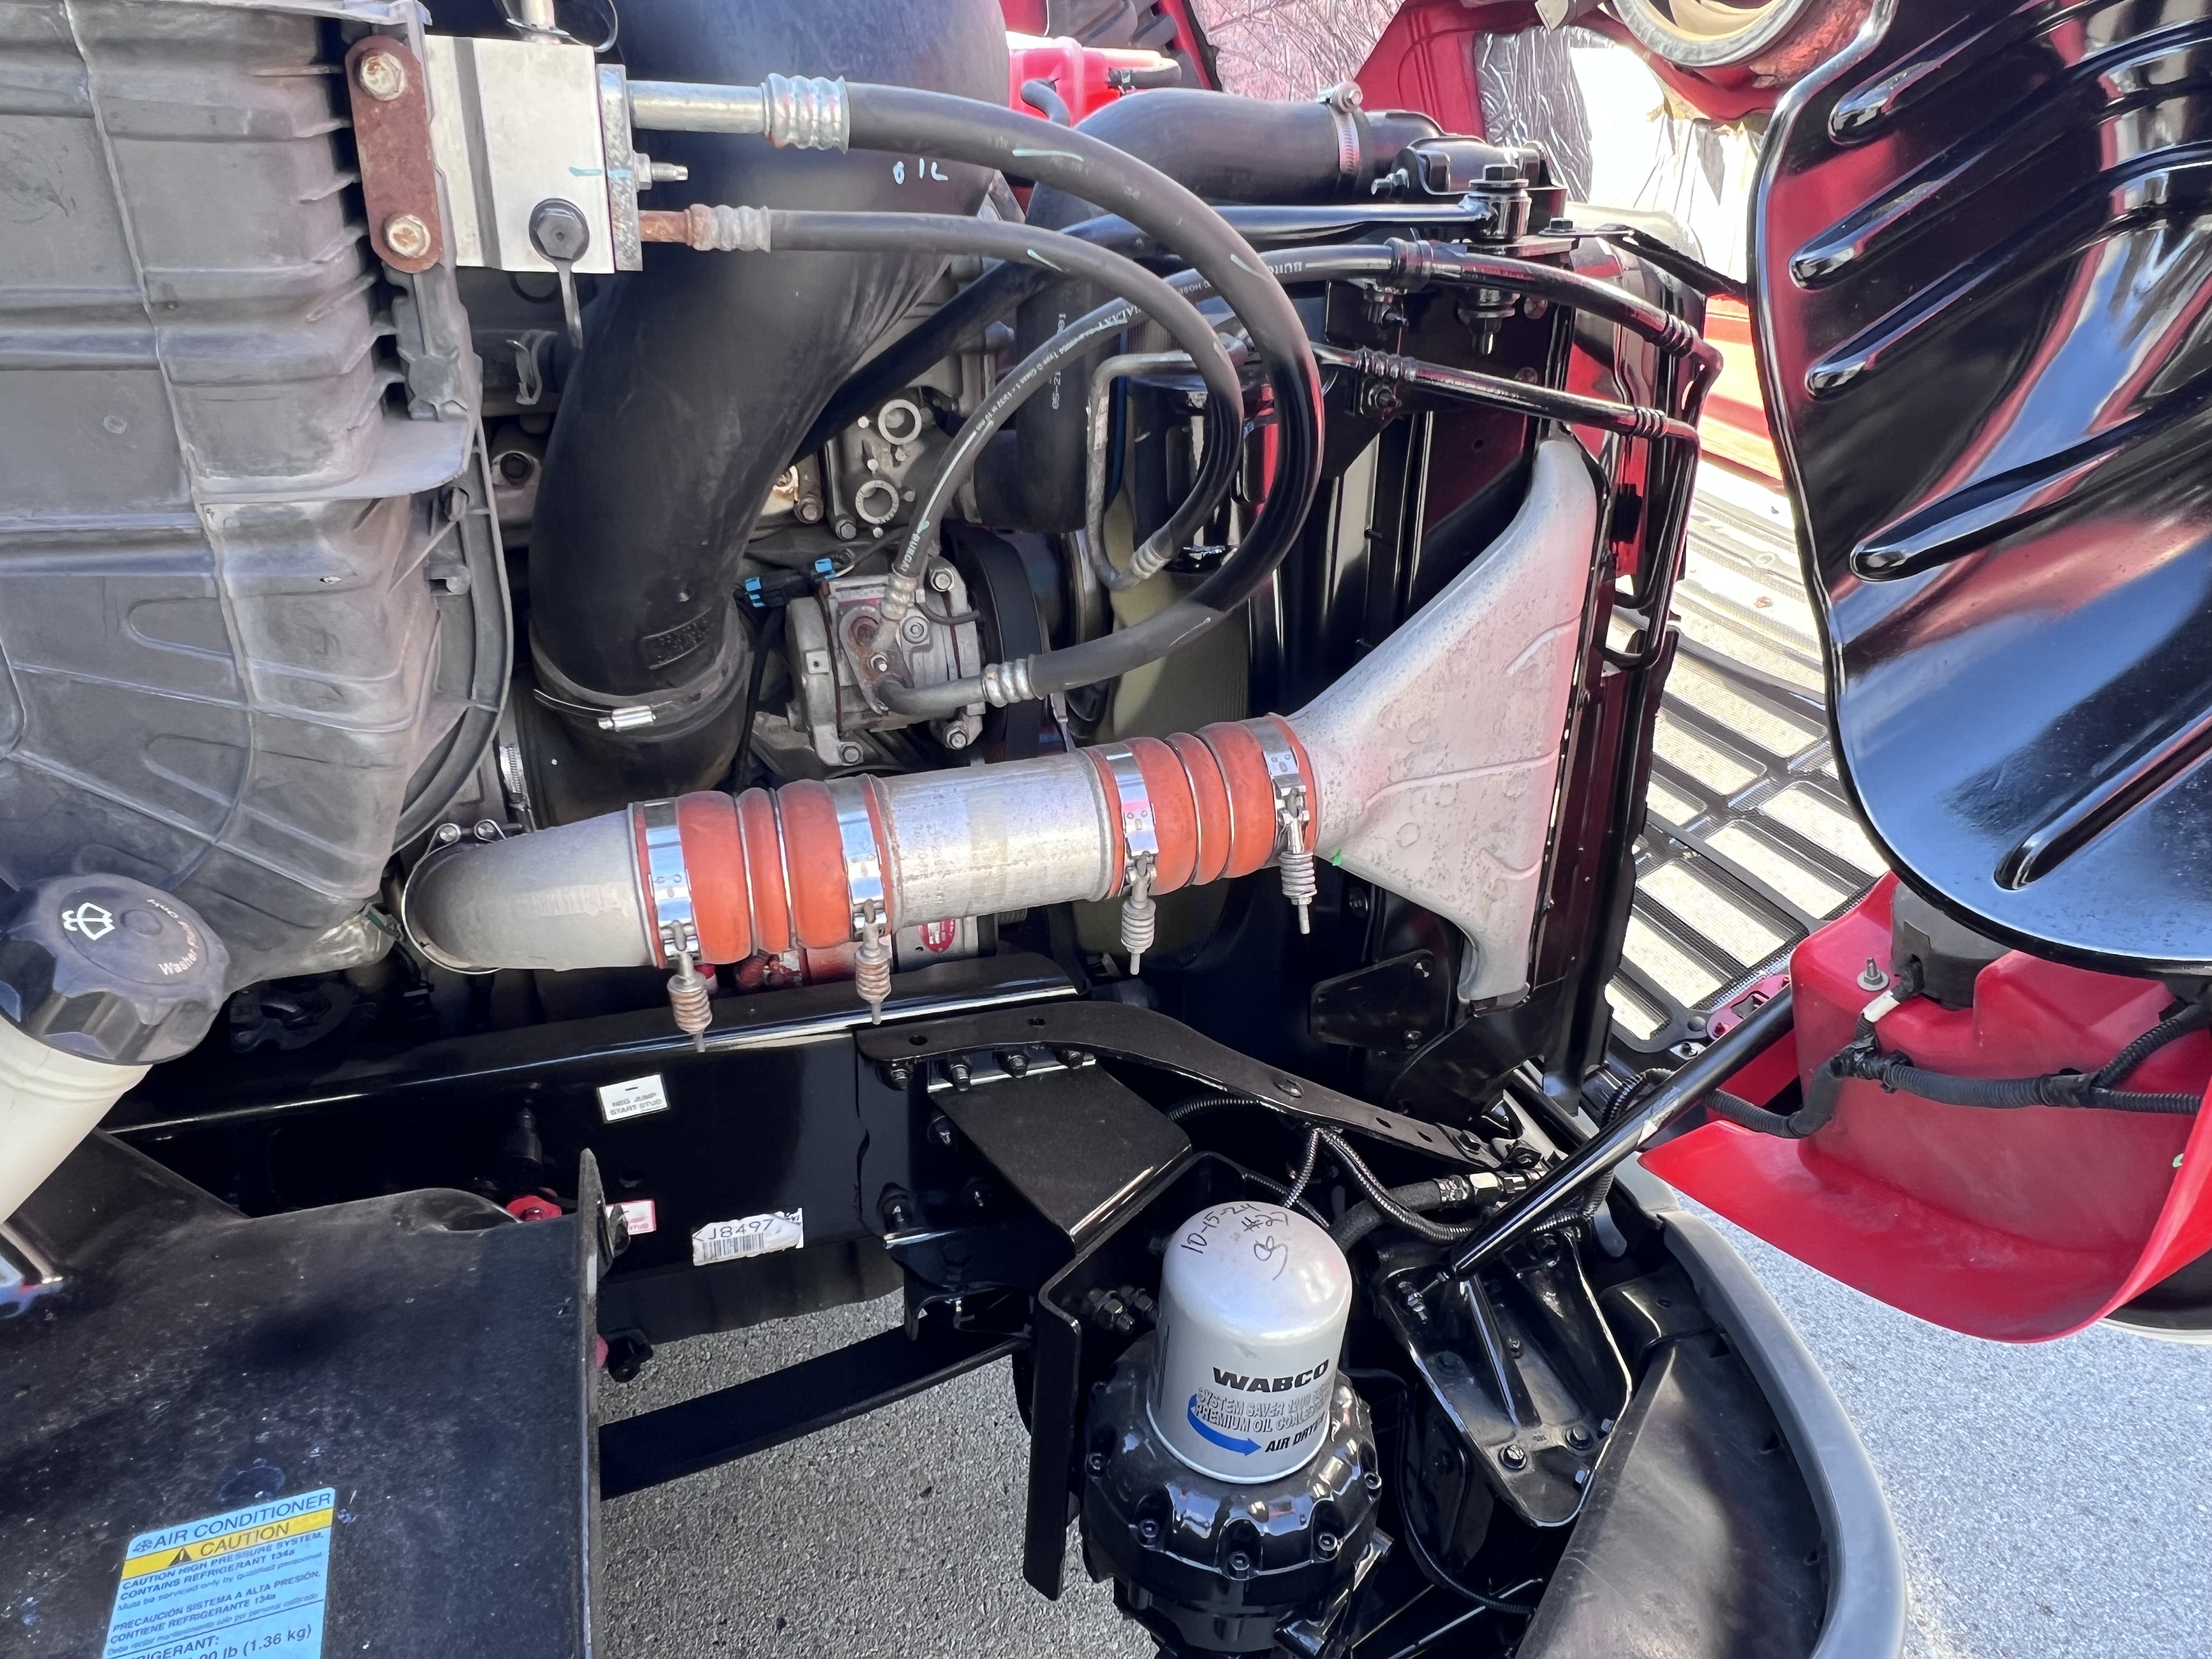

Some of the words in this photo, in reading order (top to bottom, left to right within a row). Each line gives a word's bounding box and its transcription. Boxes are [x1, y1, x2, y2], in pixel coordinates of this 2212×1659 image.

[158, 948, 198, 975] Washer
[1212, 1358, 1329, 1393] WABCO
[1194, 1403, 1251, 1433] PREMIUM
[1252, 1418, 1273, 1433] OIL
[1197, 1386, 1245, 1416] SYSTEM
[1245, 1401, 1285, 1418] SAVER
[1265, 1436, 1291, 1453] AIR
[153, 1529, 188, 1549] AIR
[194, 1493, 331, 1538] CONDITIONER
[200, 1522, 290, 1556] CAUTION
[120, 1578, 181, 1601] CONTAINS
[183, 1555, 267, 1584] REFRIGERANT
[122, 1569, 176, 1590] CAUTION
[210, 1544, 273, 1564] PRESSURE
[234, 1591, 242, 1600] A
[245, 1583, 271, 1596] ALTA
[110, 1622, 166, 1644] CONTIENE
[168, 1599, 250, 1628] REFRIGERANTE
[223, 1646, 238, 1659] lb
[243, 1633, 282, 1657] (1.36
[287, 1623, 312, 1642] kg)
